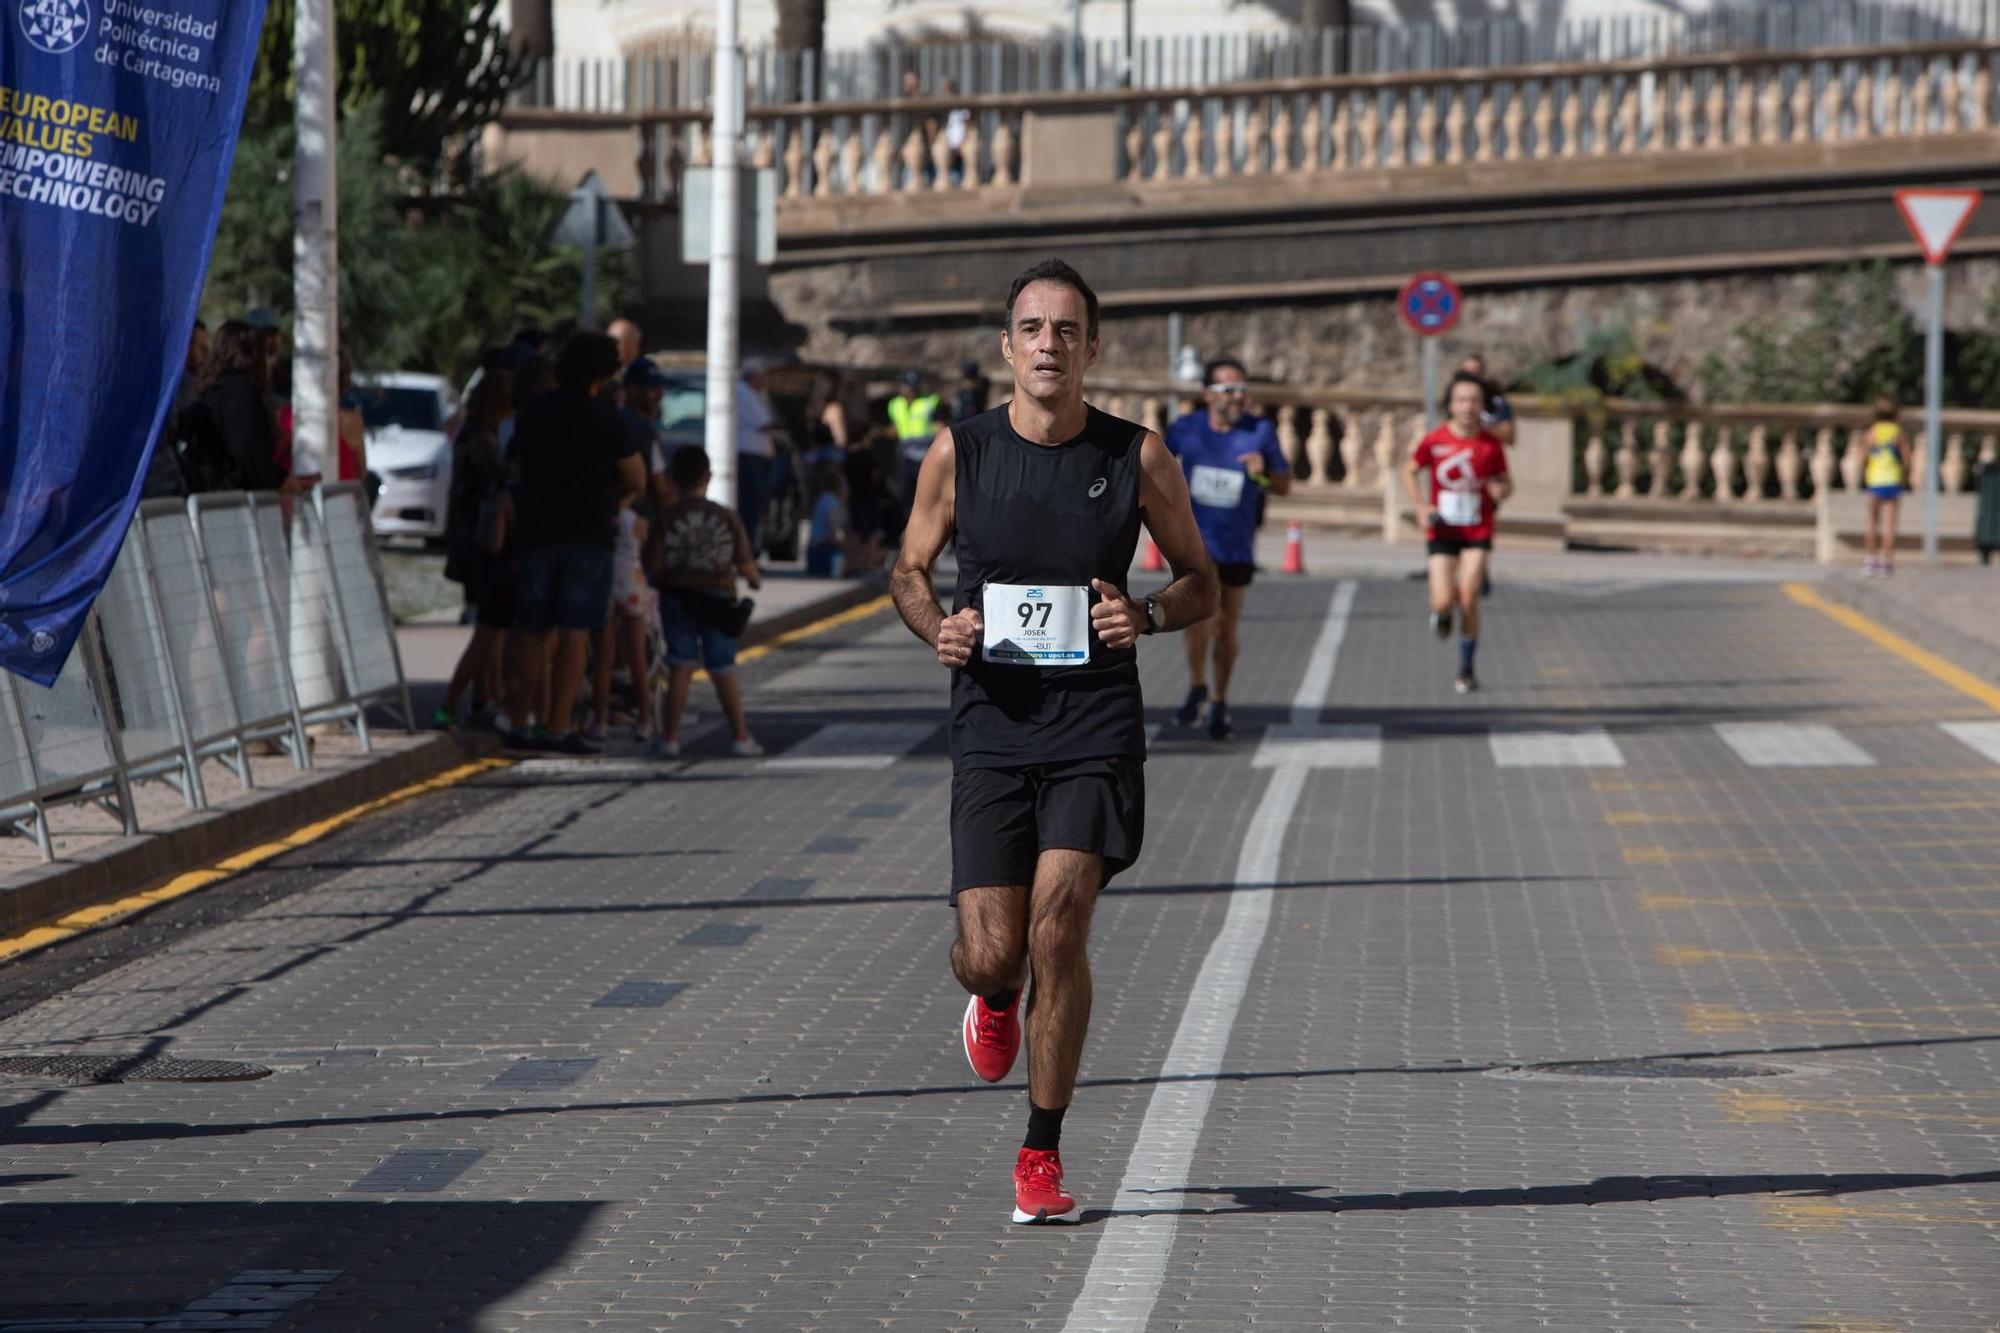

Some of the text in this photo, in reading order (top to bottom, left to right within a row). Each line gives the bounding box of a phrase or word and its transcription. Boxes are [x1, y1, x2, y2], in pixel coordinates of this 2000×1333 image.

[99, 18, 200, 62] Politécnica
[103, 0, 218, 40] Universidad
[94, 43, 221, 93] de Cartagena
[0, 168, 158, 227] ECHNOLOGY
[1017, 602, 1053, 628] 97
